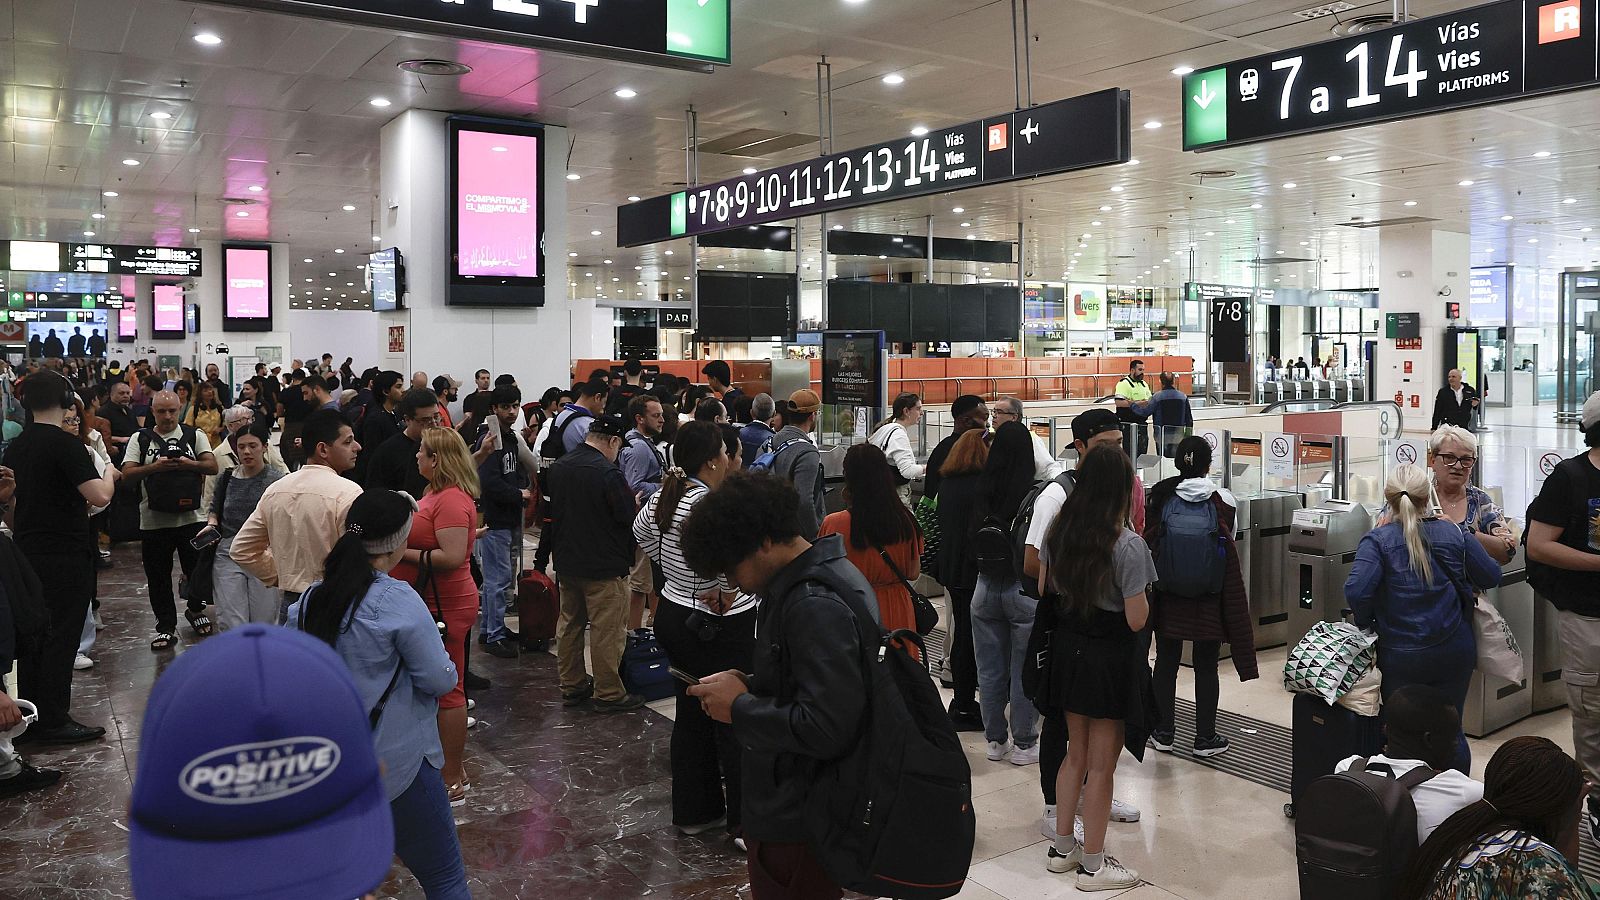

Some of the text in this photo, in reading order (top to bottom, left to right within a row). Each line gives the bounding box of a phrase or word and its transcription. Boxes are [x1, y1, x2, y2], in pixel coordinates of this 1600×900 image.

[1554, 5, 1580, 32] R
[1438, 22, 1480, 45] Vías
[1438, 49, 1481, 72] Vies
[1271, 33, 1428, 120] 7 a 14
[1438, 70, 1510, 94] PLATFORMS
[945, 132, 965, 148] Vías
[989, 128, 1001, 146] R
[945, 151, 965, 166] Vies
[944, 166, 977, 181] PLATFORMS
[1380, 411, 1389, 436] 8
[190, 746, 333, 789] POSITIVE
